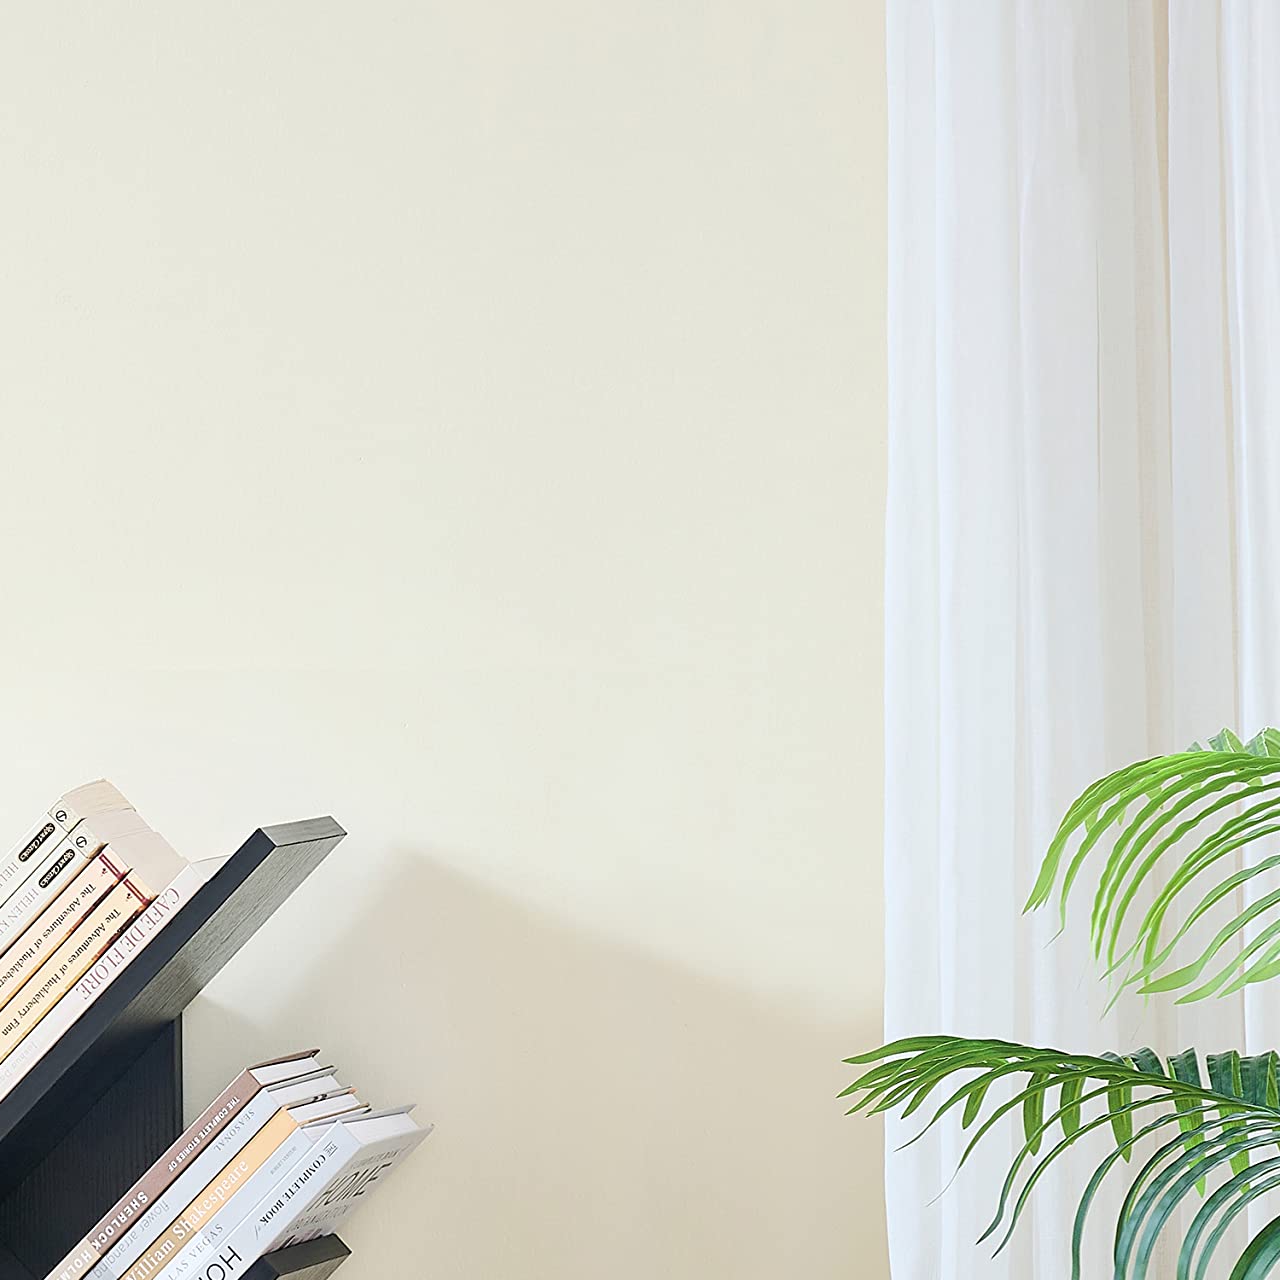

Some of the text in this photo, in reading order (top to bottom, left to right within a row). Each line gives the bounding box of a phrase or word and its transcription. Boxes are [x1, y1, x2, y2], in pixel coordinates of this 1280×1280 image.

[6, 888, 38, 922] HELEN
[80, 883, 96, 898] The
[42, 897, 81, 939] Adventures
[33, 938, 43, 949] of
[75, 887, 180, 1000] CAFE DE FLORE
[1, 908, 121, 1036] The Adventures of Huckleberry Finn
[167, 1095, 240, 1173] THE COMPLETE STORIES OF
[213, 1109, 255, 1151] SEASONAL
[282, 1154, 326, 1201] COMPLETE
[88, 1190, 150, 1253] SHERLOCK
[170, 1160, 250, 1243] Shakespeare
[259, 1199, 284, 1224] BOOK
[93, 1199, 170, 1277] flower arranging
[189, 1223, 223, 1258] VEGAS
